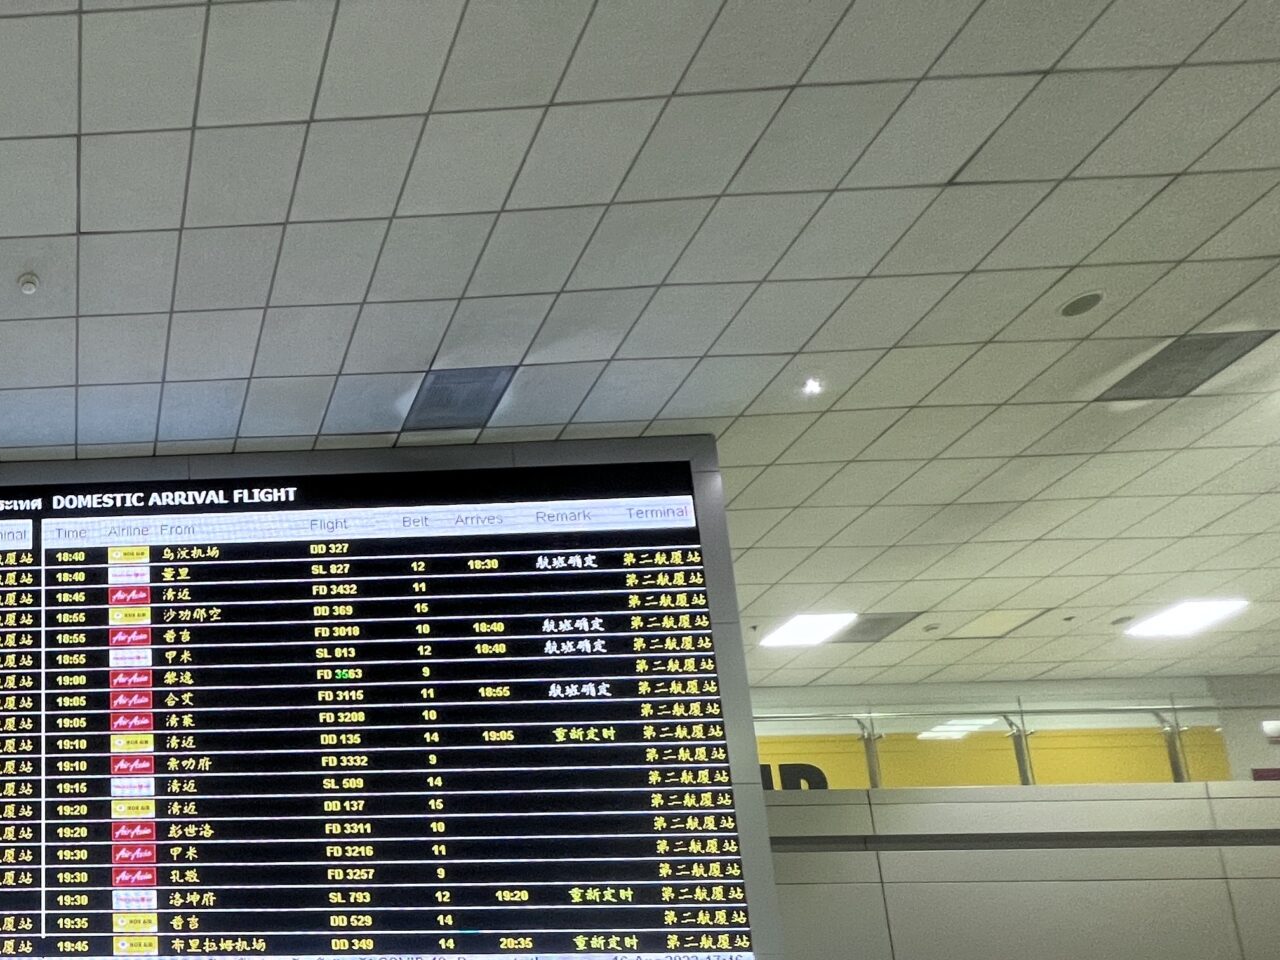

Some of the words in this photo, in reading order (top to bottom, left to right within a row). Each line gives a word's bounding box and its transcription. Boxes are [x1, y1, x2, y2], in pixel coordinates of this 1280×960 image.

[52, 492, 144, 510] DOMESTIC
[148, 489, 228, 507] ARRIVAL
[233, 487, 297, 503] FLIGHT
[56, 527, 87, 539] Time
[160, 524, 195, 536] From
[310, 518, 349, 533] Flight
[402, 515, 429, 528] Belt
[454, 513, 503, 526] Arrives
[536, 510, 592, 522] Remark
[626, 506, 688, 519] Terminal
[309, 543, 327, 555] DD
[328, 542, 349, 554] 327
[55, 551, 86, 562] 18:40
[467, 558, 499, 570] 18:30
[55, 571, 86, 583] 18:40
[312, 584, 328, 596] FD
[329, 583, 358, 595] 3432
[55, 591, 86, 603] 18:45
[313, 605, 330, 617] DD
[332, 605, 354, 616] 369
[55, 612, 86, 623] 18:55
[56, 633, 86, 644] 18:55
[56, 653, 87, 665] 18:55
[56, 674, 87, 686] 19:00
[317, 690, 334, 702] FD
[335, 689, 364, 701] 3115
[478, 686, 511, 698] 18:55
[56, 695, 87, 707] 19:05
[56, 717, 87, 729] 19:05
[320, 733, 338, 745] DD
[339, 733, 362, 745] 135
[482, 730, 515, 742] 19:05
[56, 738, 87, 750] 19:10
[56, 760, 88, 772] 19:10
[321, 755, 338, 767] FD
[339, 755, 369, 767] 3332
[56, 782, 88, 794] 19:15
[56, 804, 88, 816] 19:20
[323, 800, 342, 812] DD
[343, 799, 365, 811] 137
[56, 826, 88, 838] 19:20
[324, 823, 342, 834] FD
[343, 822, 372, 834] 3311
[56, 849, 88, 861] 19:30
[325, 845, 343, 857] FD
[344, 845, 374, 857] 3216
[56, 871, 89, 884] 19:30
[327, 868, 344, 880] FD
[345, 868, 375, 880] 3257
[56, 894, 89, 906] 19:30
[328, 892, 347, 904] SL
[348, 891, 371, 903] 793
[495, 889, 529, 902] 19:20
[56, 917, 89, 929] 19:35
[329, 915, 348, 927] DD
[349, 914, 373, 927] 529
[56, 940, 89, 952] 19:45
[331, 938, 350, 951] DD
[351, 938, 374, 950] 349
[499, 937, 534, 949] 20:35
